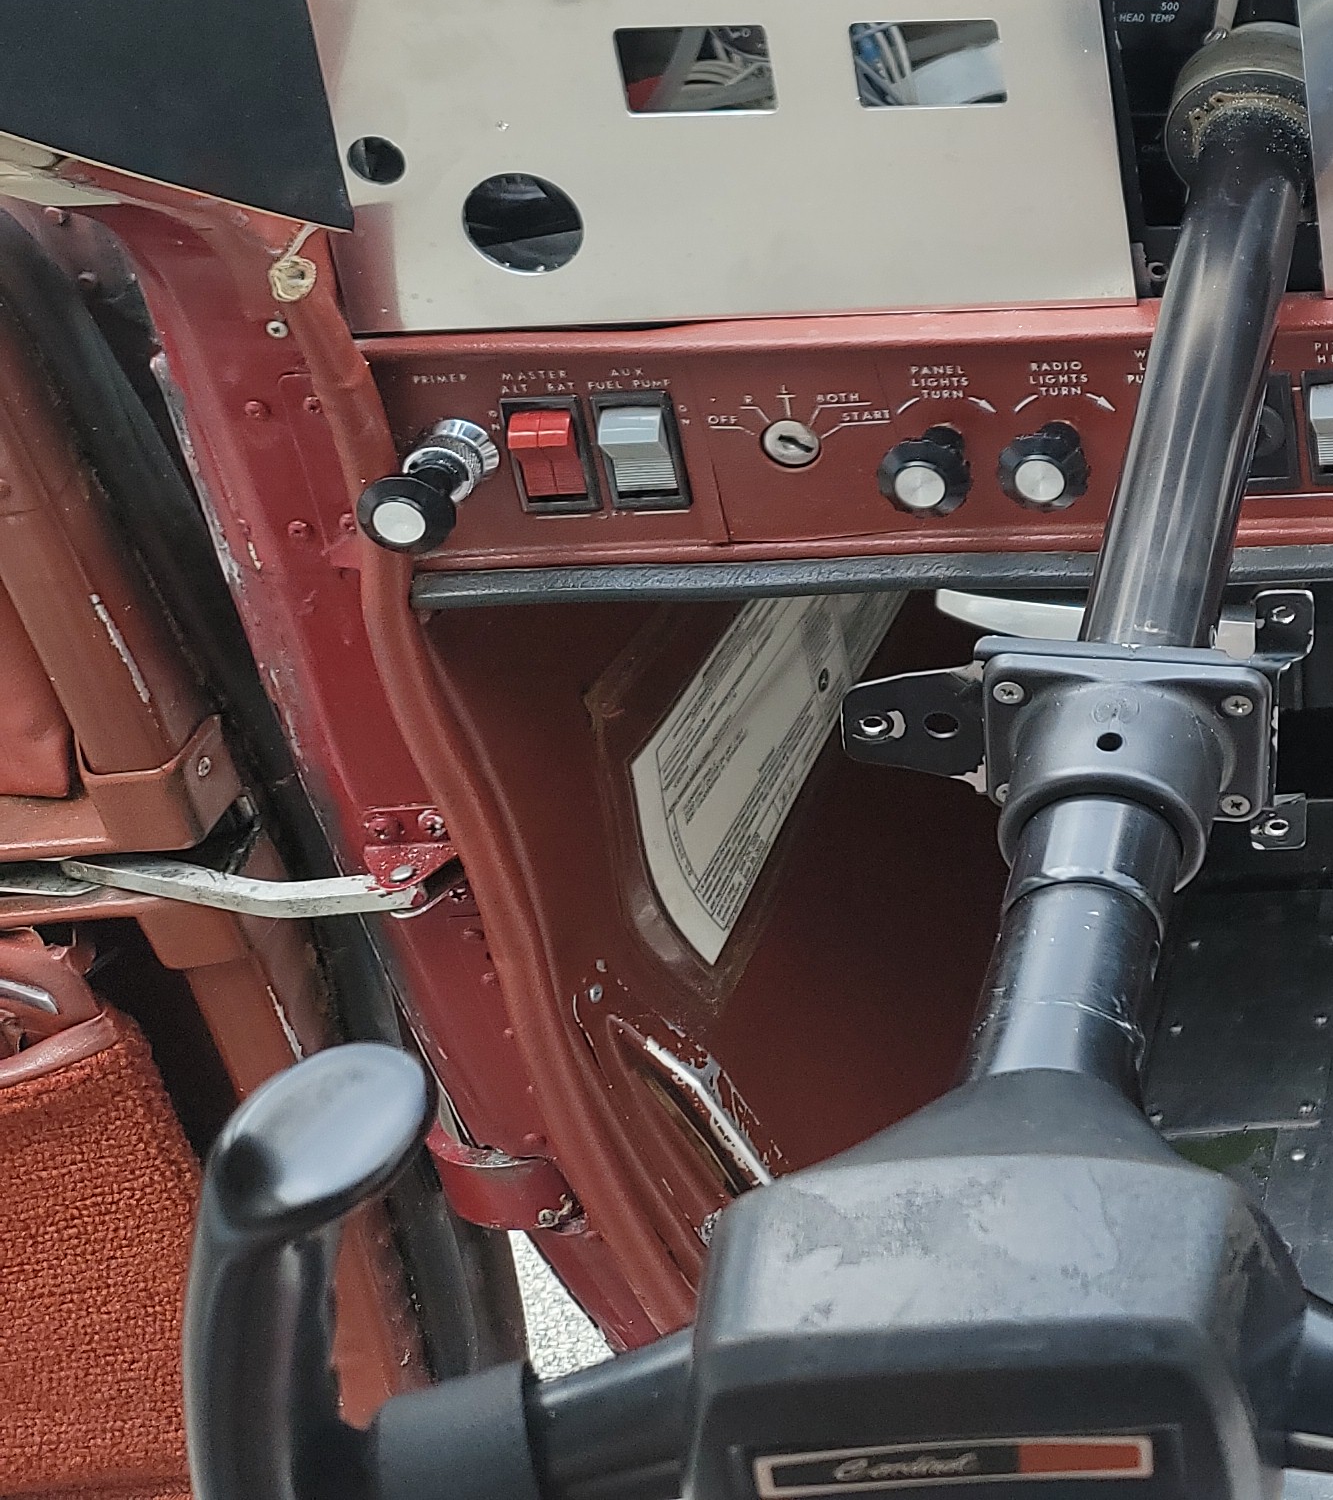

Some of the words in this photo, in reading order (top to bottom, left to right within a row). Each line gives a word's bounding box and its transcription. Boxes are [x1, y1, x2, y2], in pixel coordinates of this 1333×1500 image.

[1160, 1, 1180, 12] 500
[1119, 13, 1145, 23] HEAD
[1150, 13, 1176, 24] TEMP
[610, 367, 645, 379] AUX
[910, 364, 966, 376] PANEL
[1029, 361, 1083, 373] RADIO
[412, 373, 468, 385] PRIMER
[501, 369, 569, 382] MASTER
[1029, 373, 1089, 385] LIGHTS
[587, 380, 624, 392] FUEL
[632, 378, 672, 389] PUMP
[911, 376, 970, 388] LIGHTS
[501, 382, 529, 395] ALT
[920, 389, 965, 400] TURN
[1039, 386, 1083, 397] TURN
[743, 395, 753, 405] R
[816, 393, 861, 404] BOTH
[707, 414, 739, 426] OFF
[841, 409, 891, 422] START
